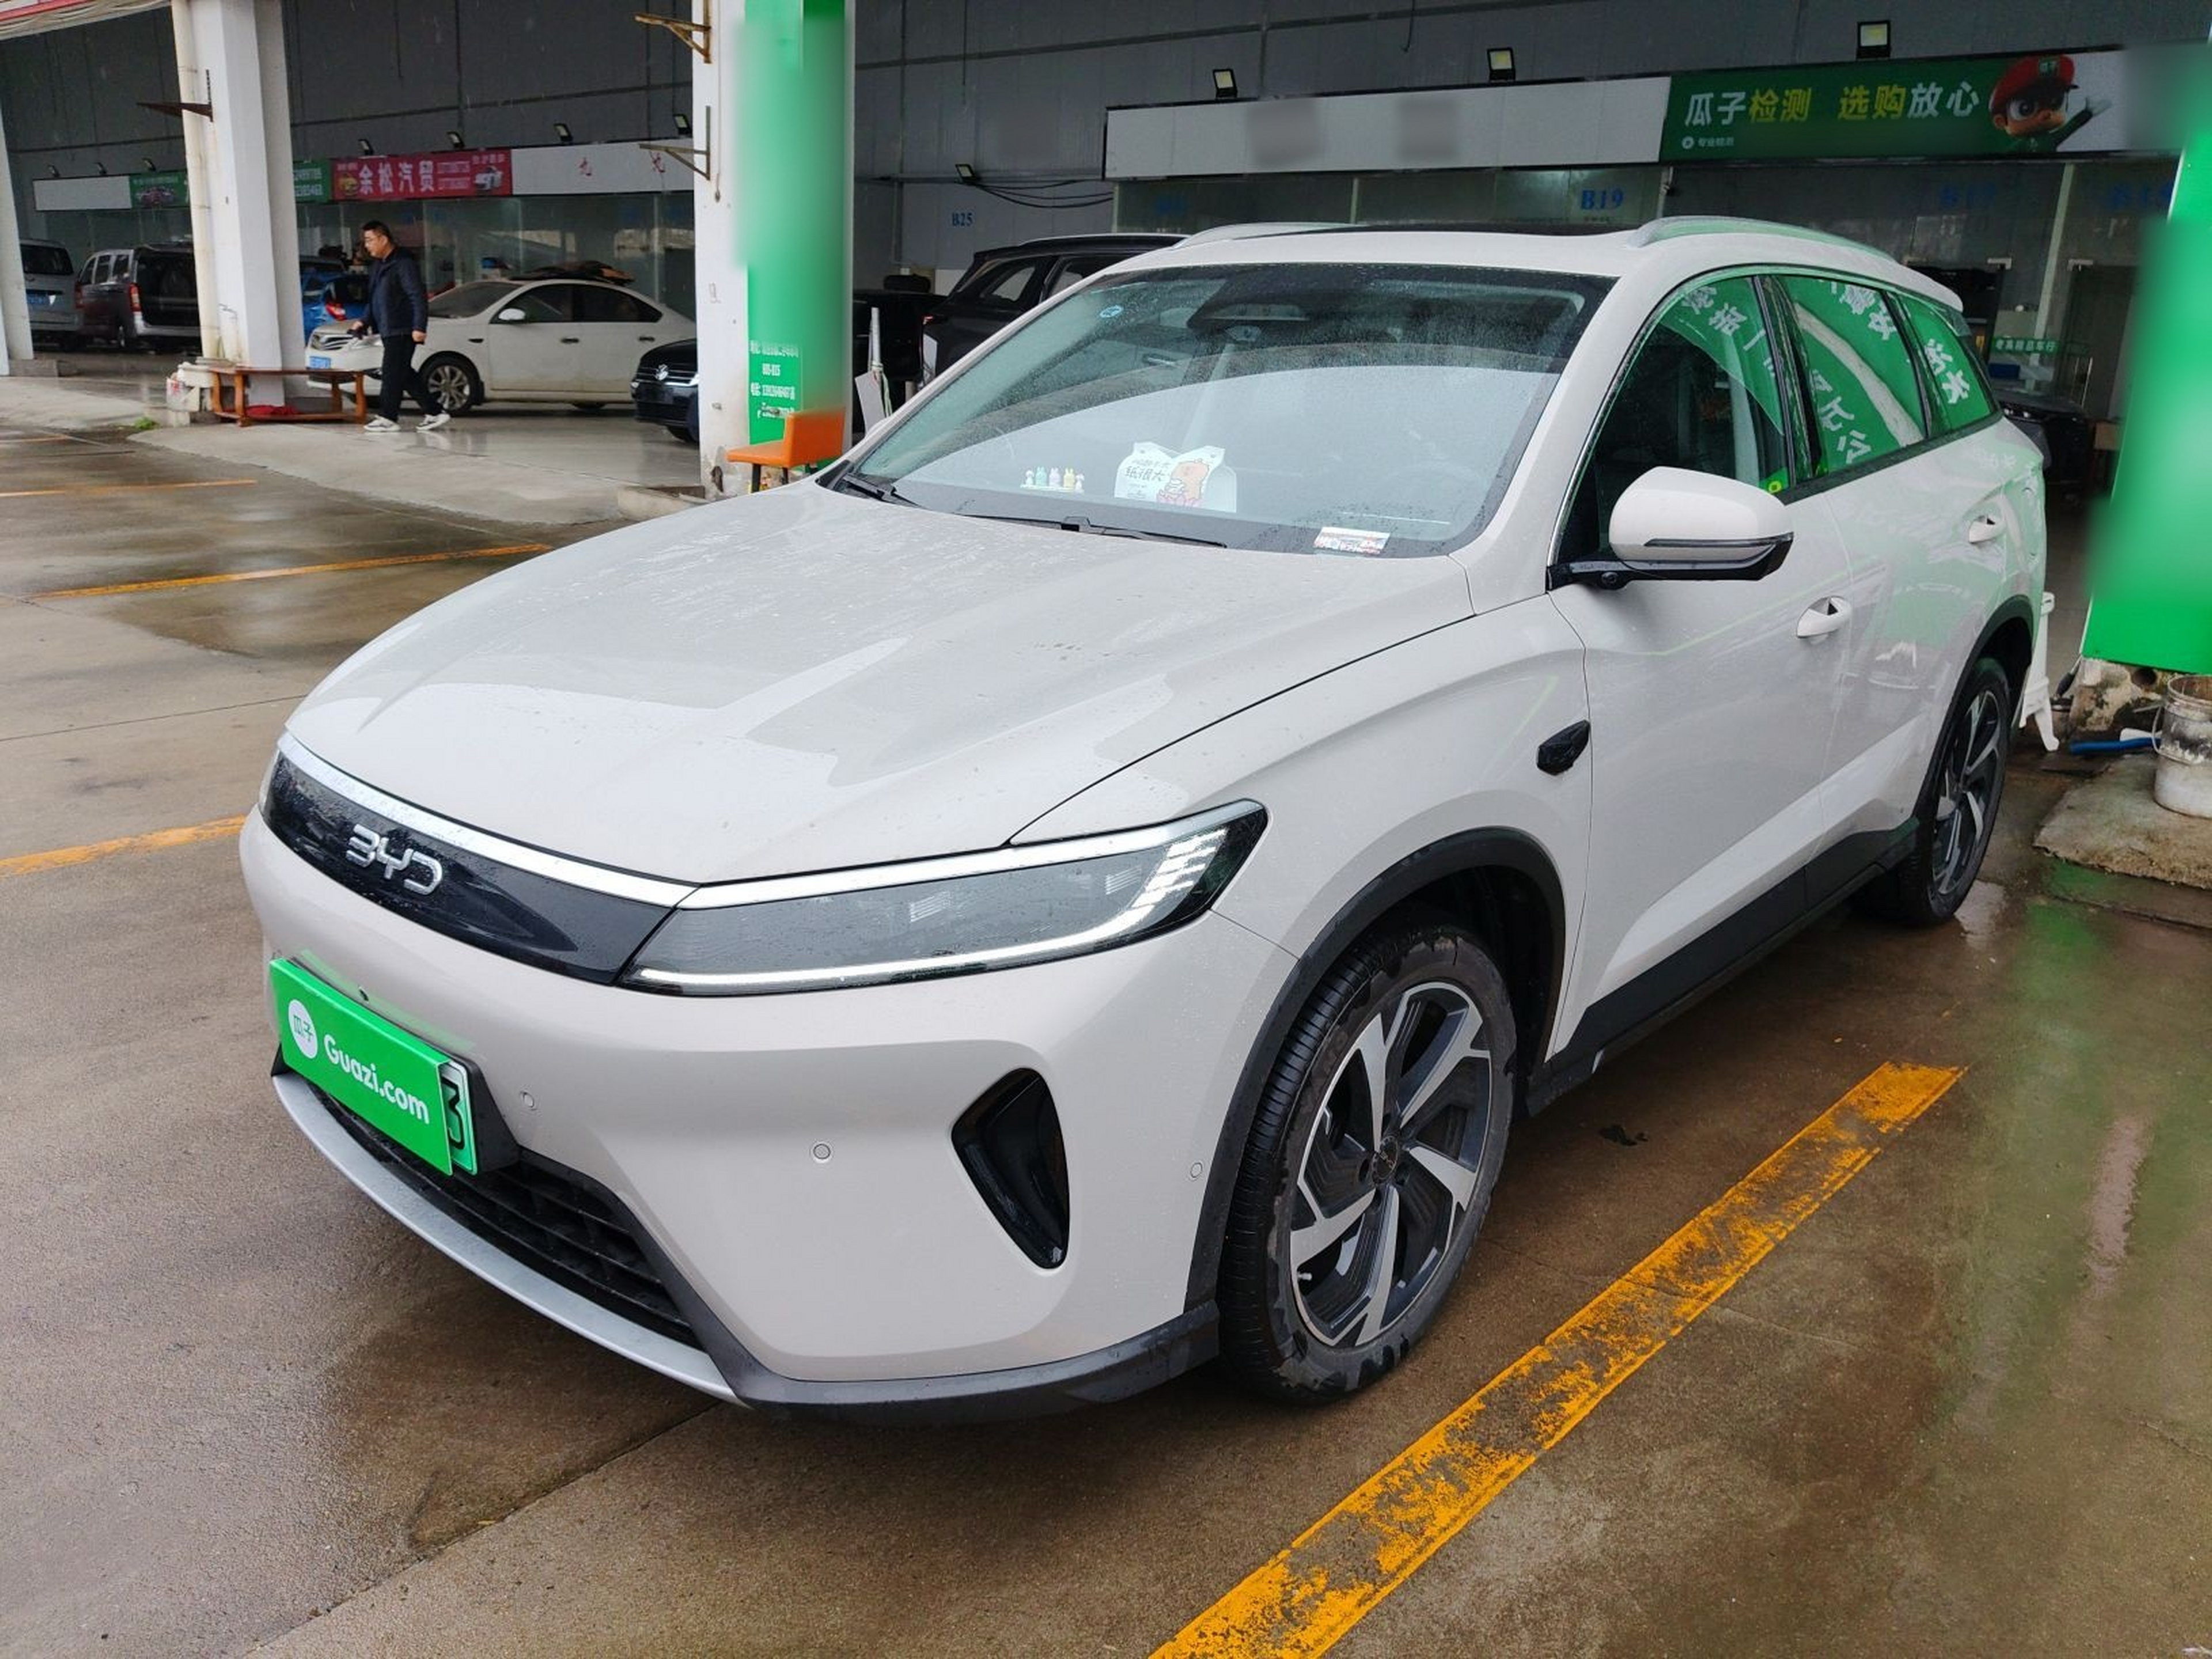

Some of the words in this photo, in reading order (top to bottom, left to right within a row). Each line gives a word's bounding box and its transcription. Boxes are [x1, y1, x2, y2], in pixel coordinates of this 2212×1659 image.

[1685, 87, 1812, 127] 瓜子检测
[1837, 81, 1980, 120] 选购放心
[951, 212, 974, 228] B25
[1581, 187, 1624, 210] B19
[346, 824, 443, 895] BYD
[323, 1034, 430, 1125] Guazi.com
